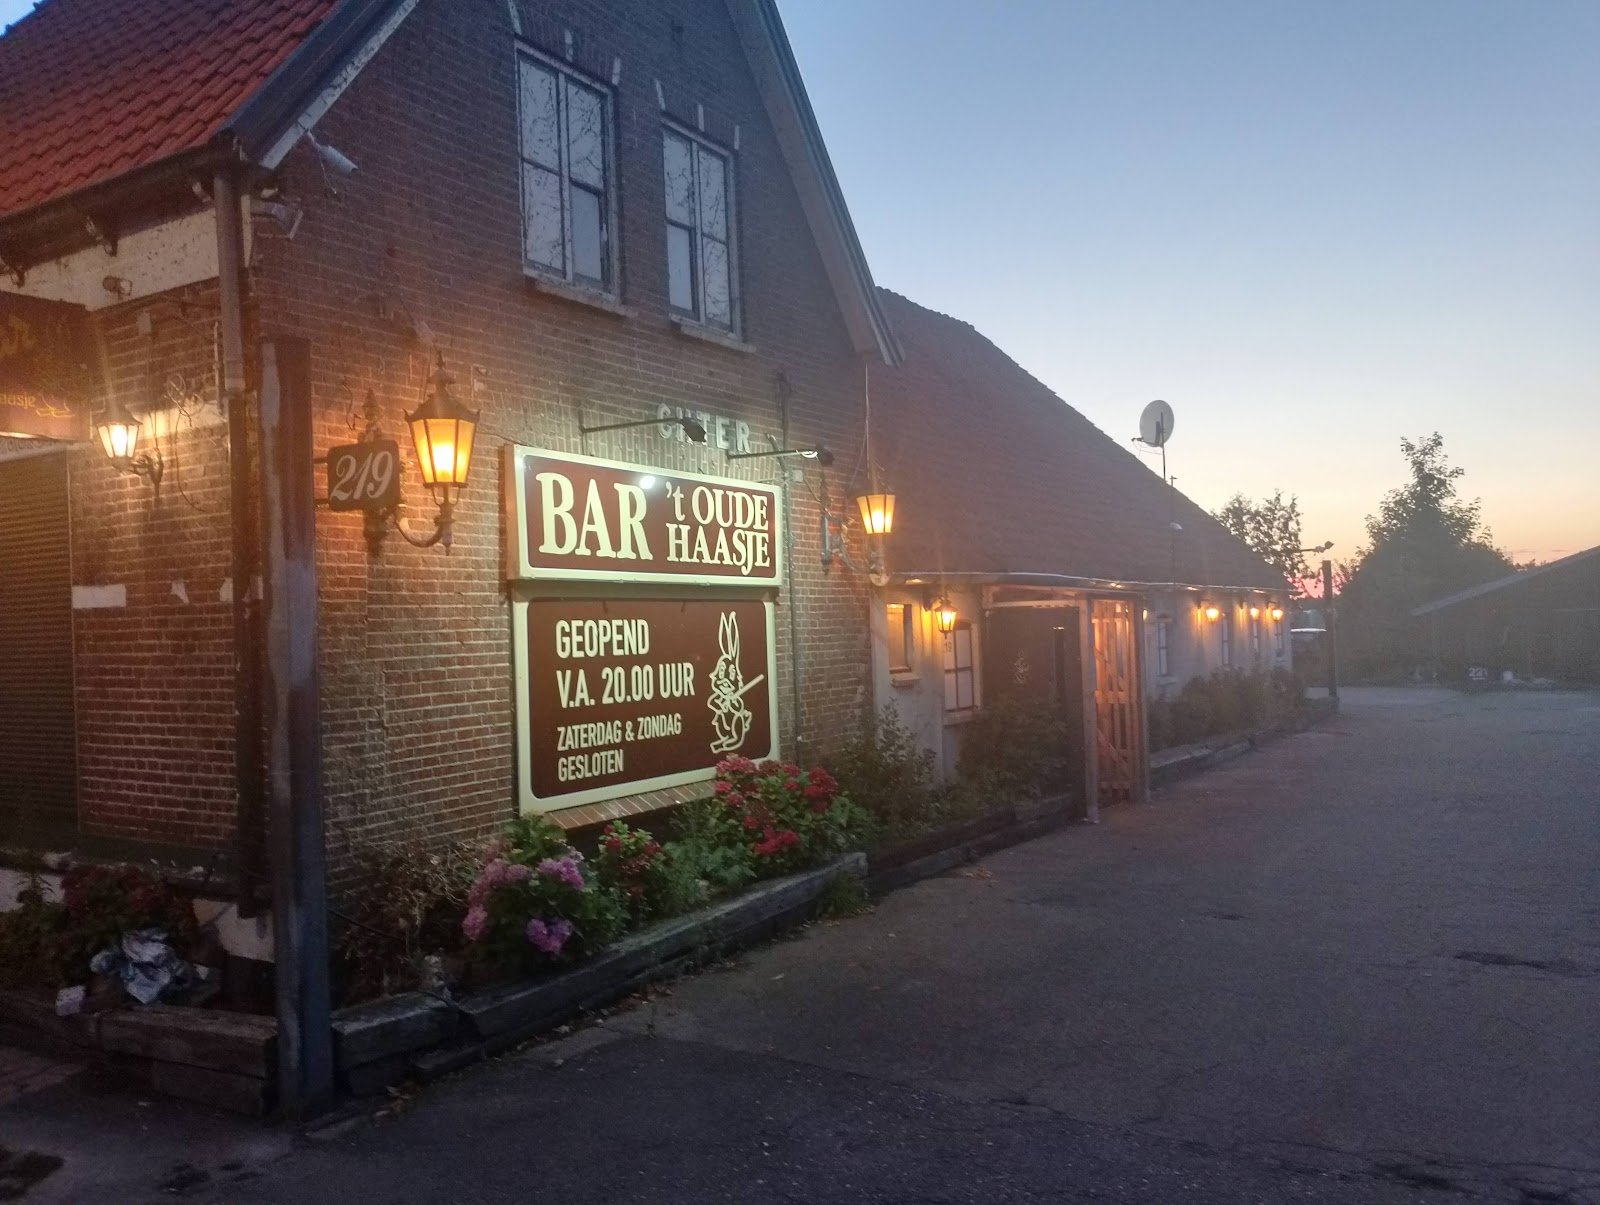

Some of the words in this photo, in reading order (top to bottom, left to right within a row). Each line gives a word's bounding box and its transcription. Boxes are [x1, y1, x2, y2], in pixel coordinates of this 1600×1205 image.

[330, 451, 393, 501] 219
[536, 472, 653, 560] BAR
[691, 486, 768, 531] OUDE
[666, 523, 770, 576] HAASJE
[556, 619, 650, 659] GEOPEND
[556, 669, 595, 709] V.A.
[602, 664, 654, 705] 20.00
[659, 662, 695, 699] UUR
[557, 720, 623, 751] ZATERDAG
[625, 721, 635, 741] &
[637, 713, 681, 740] ZONDAG
[558, 749, 624, 782] GESLOTEN
